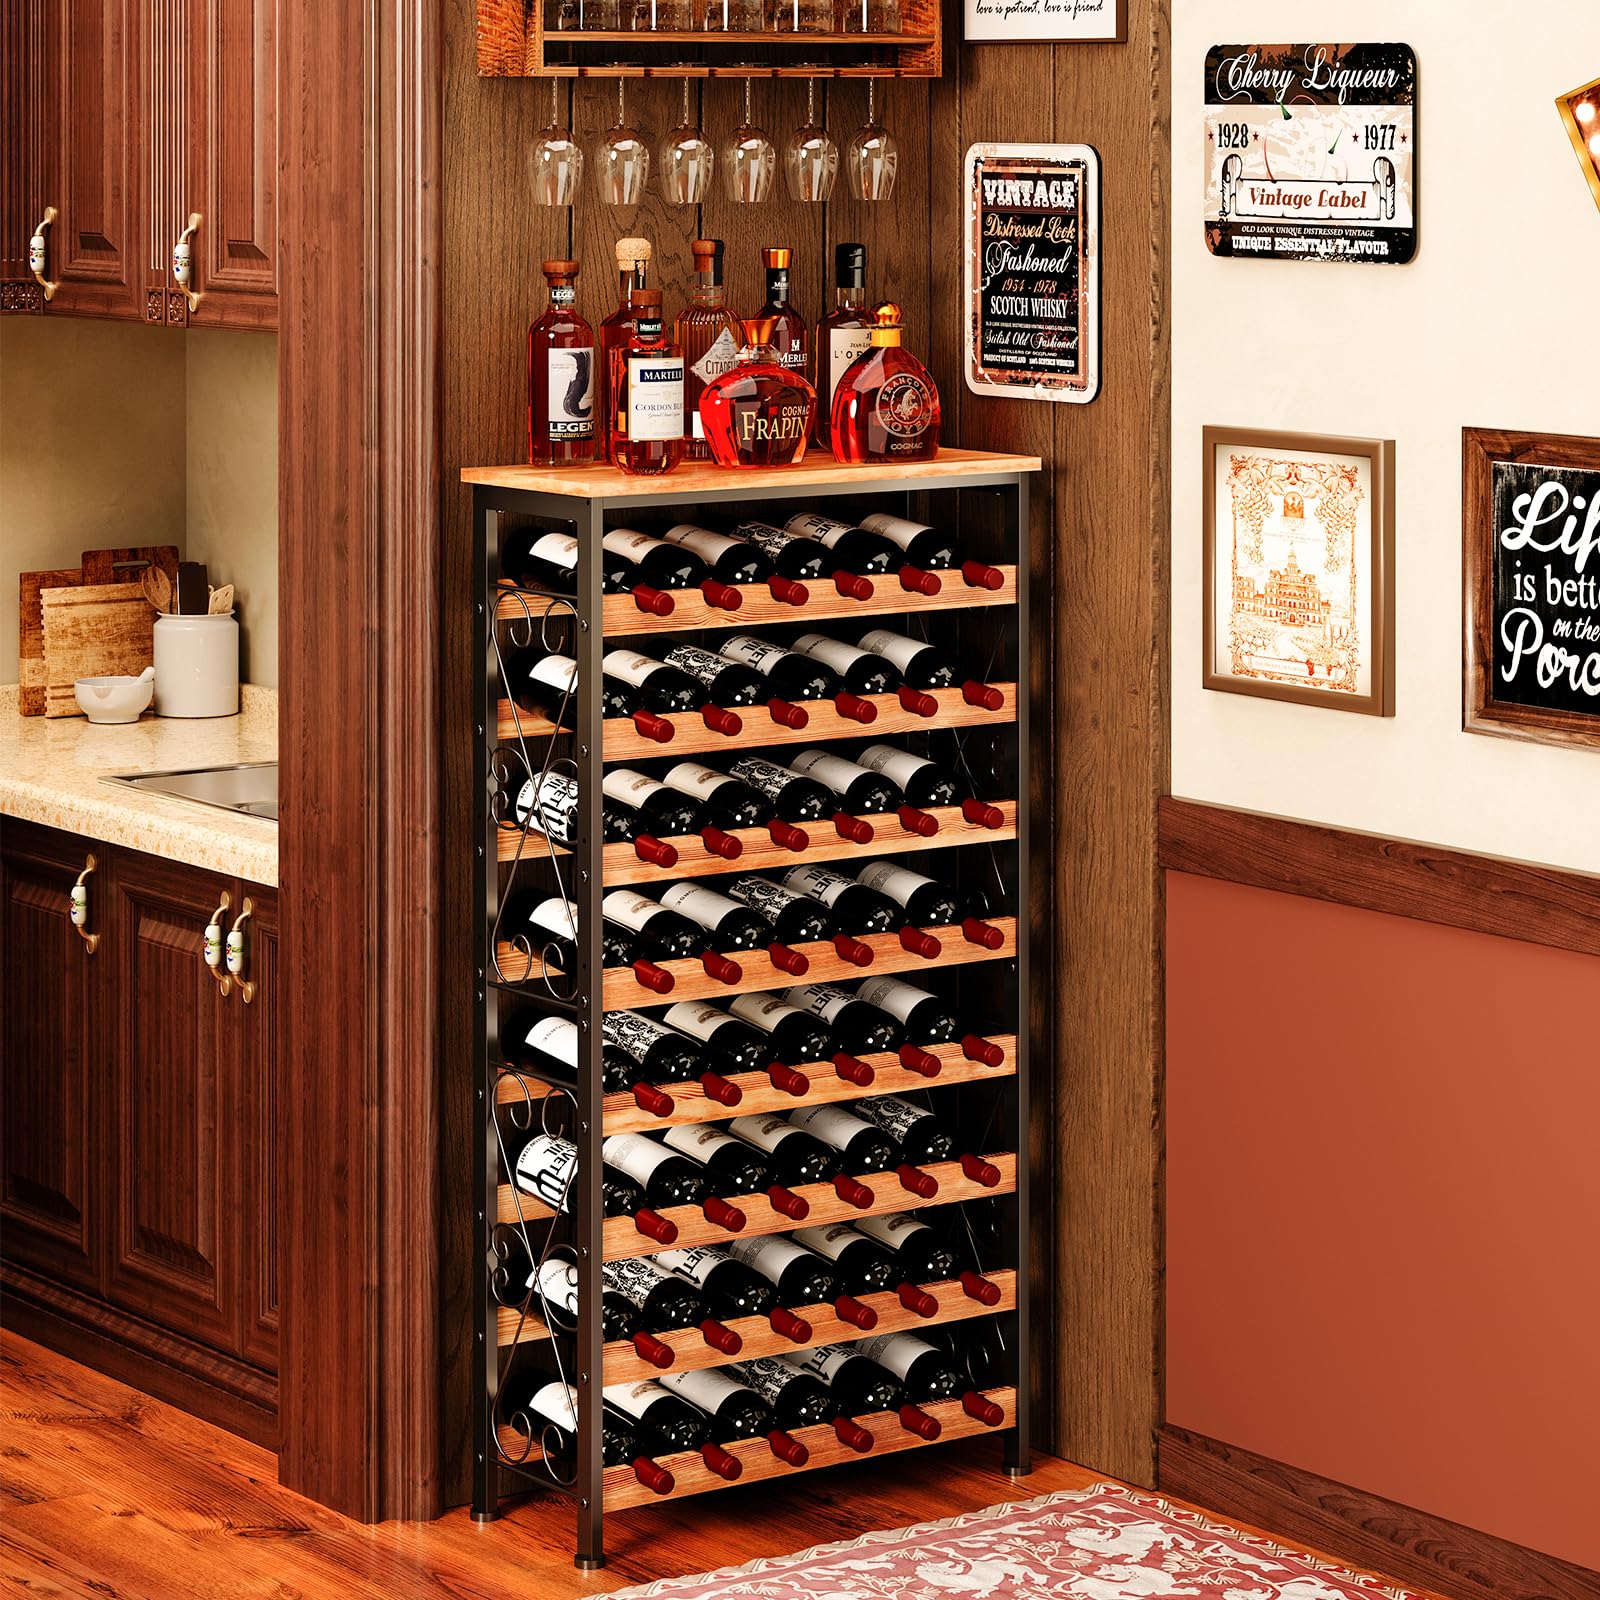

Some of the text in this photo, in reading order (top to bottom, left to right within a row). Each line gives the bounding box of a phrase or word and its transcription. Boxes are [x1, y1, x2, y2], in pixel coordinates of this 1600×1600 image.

[976, 0, 993, 14] love
[995, 4, 1004, 14] is
[1044, 0, 1062, 13] love
[1064, 3, 1072, 12] is
[1216, 44, 1399, 105] Cherry Liqueur
[1218, 123, 1396, 150] 1928 1977
[983, 180, 1075, 208] VINTAGE
[1249, 188, 1366, 209] Vintage Label
[984, 213, 1076, 244] Distressed Look
[1256, 226, 1274, 234] LOOK
[1276, 227, 1302, 236] UNIQUE
[1304, 228, 1344, 236] DISTRESSED
[1345, 229, 1374, 237] VINTAGE
[1232, 236, 1272, 252] UNIQUE
[1034, 280, 1058, 293] 1978
[990, 296, 1068, 318] SCOTCH WHISKY
[1012, 332, 1030, 346] Old
[782, 405, 810, 416] COGNAC
[741, 412, 809, 440] FRAPIN
[890, 442, 924, 450] COGNAC
[1500, 480, 1600, 574] Lif
[1512, 560, 1600, 610] is bett
[1552, 616, 1600, 642] on the
[1500, 607, 1600, 696] Porc
